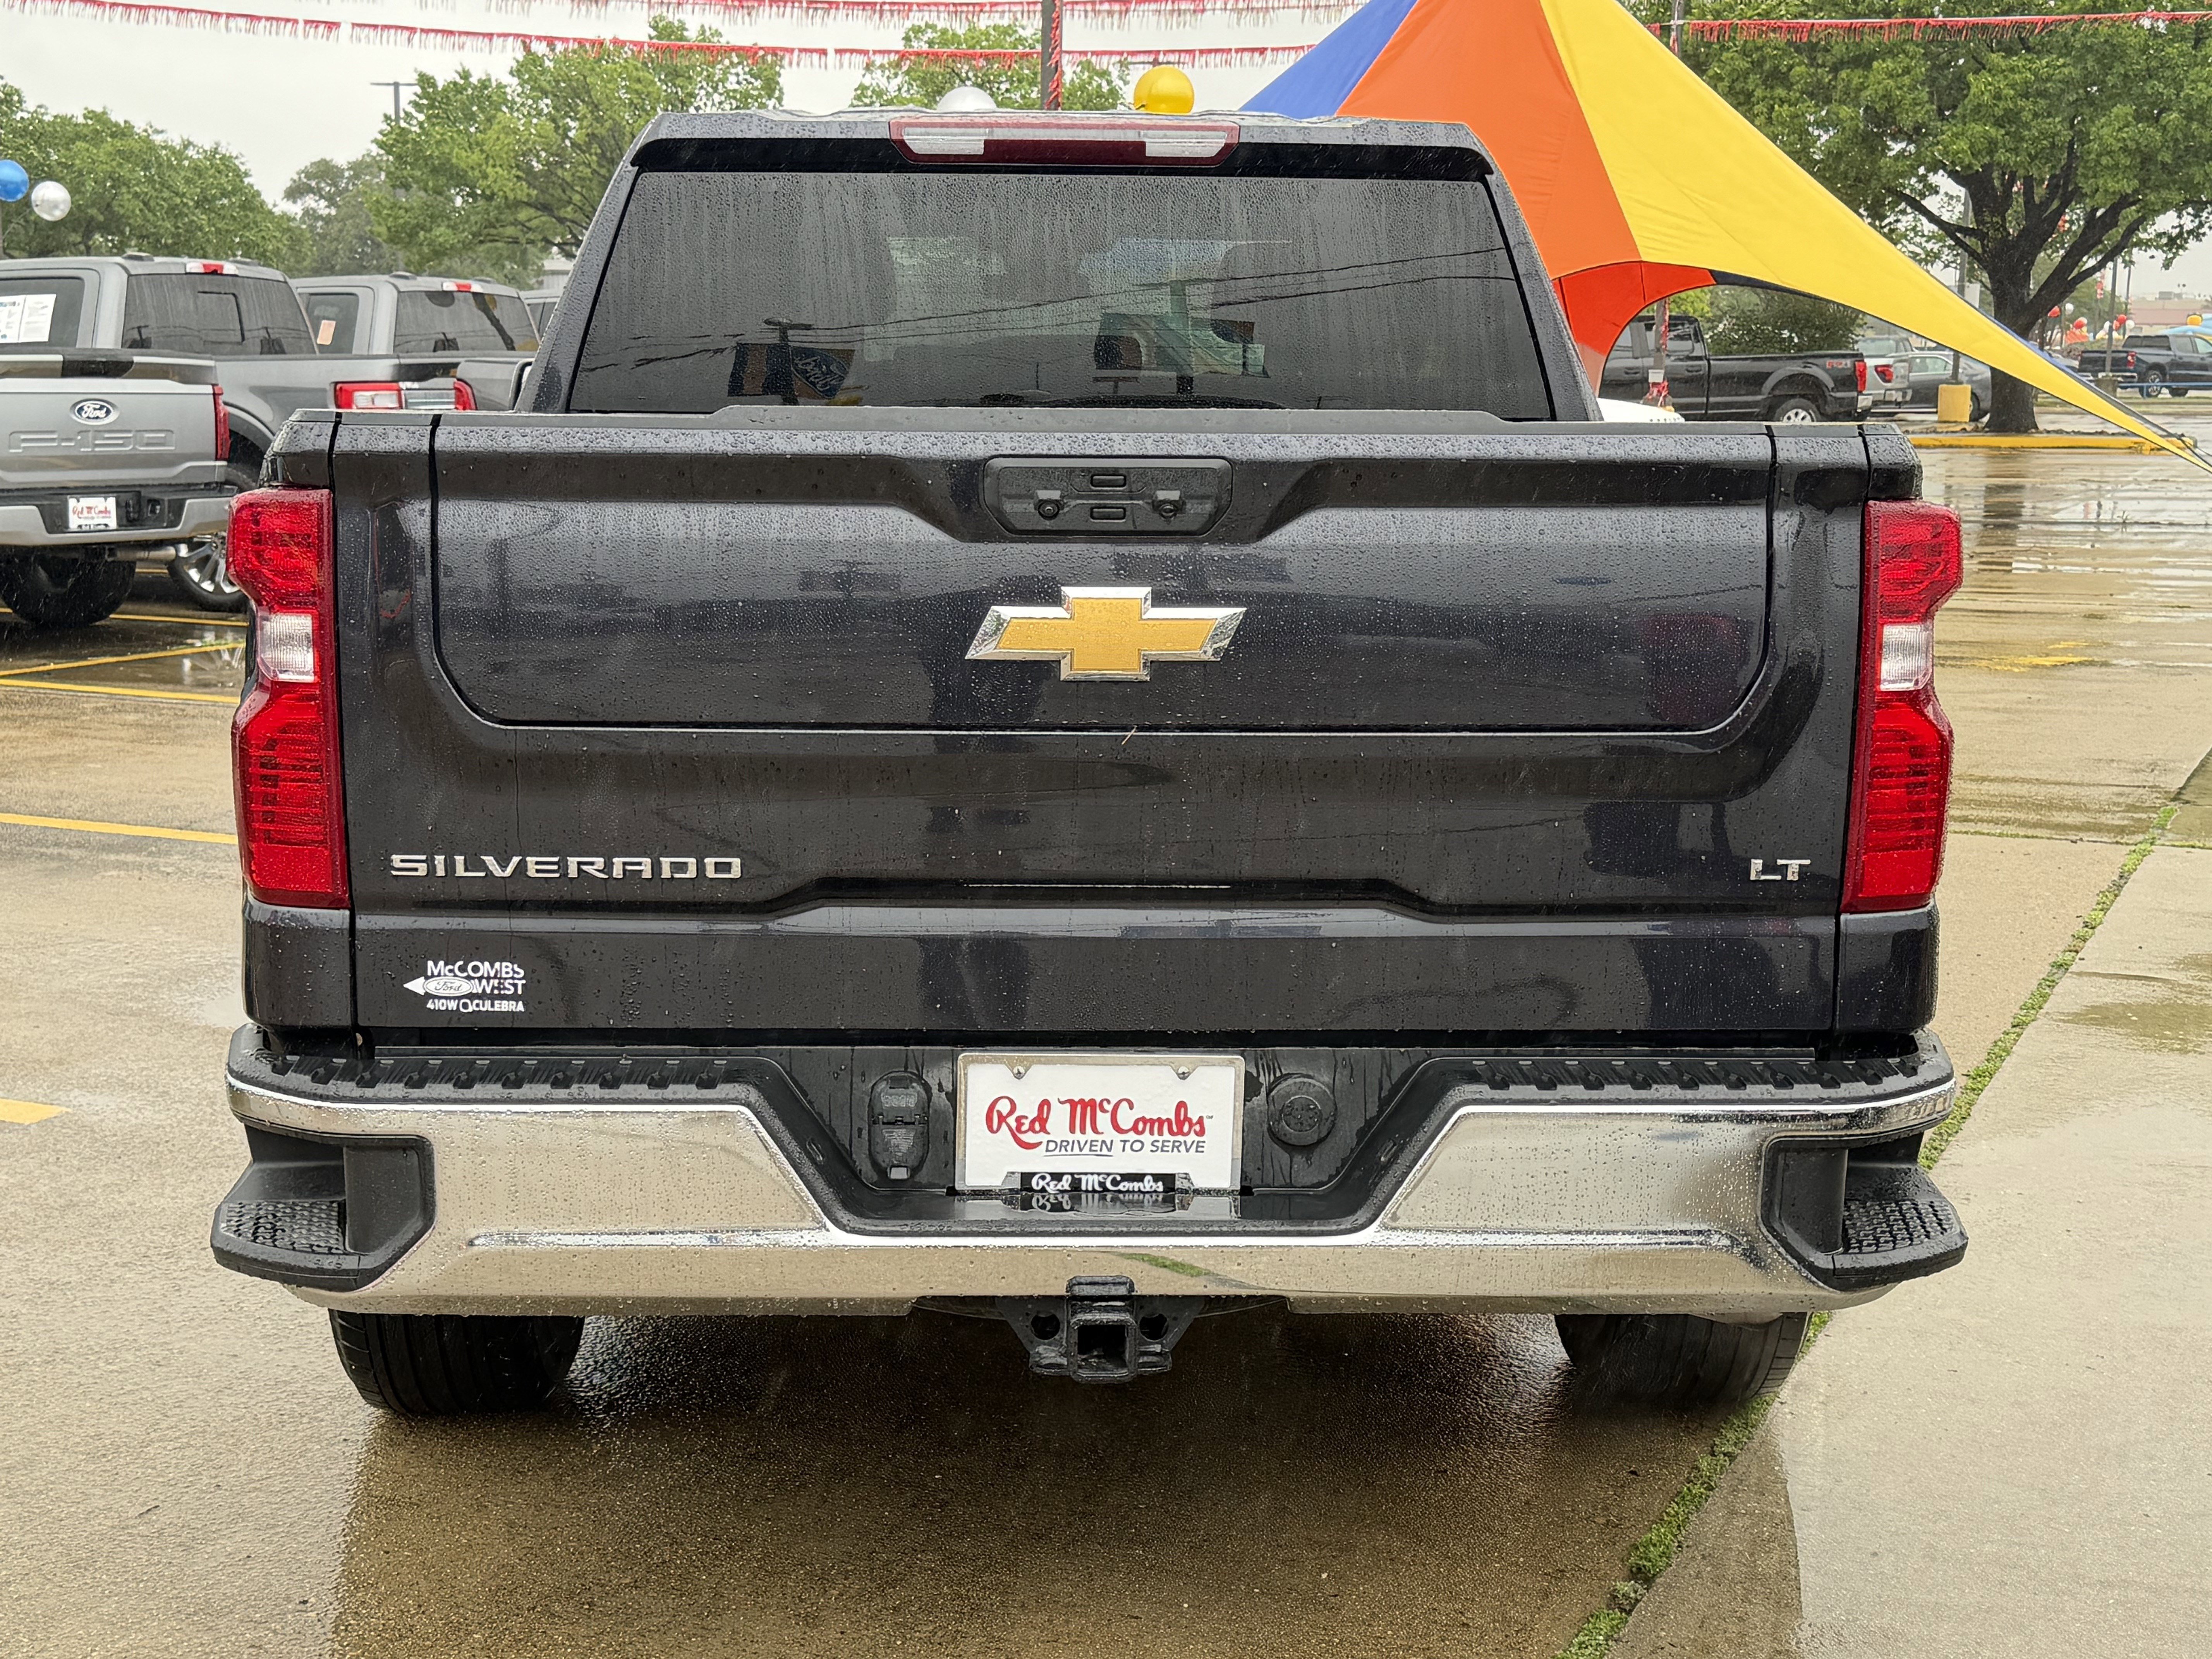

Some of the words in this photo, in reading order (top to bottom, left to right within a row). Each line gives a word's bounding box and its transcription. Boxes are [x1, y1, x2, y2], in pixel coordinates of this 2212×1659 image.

[81, 403, 107, 419] Ford
[9, 429, 175, 452] F-150
[390, 854, 741, 879] SILVERADO
[1750, 859, 1811, 881] LT
[427, 960, 525, 978] McCOMBS
[435, 981, 463, 992] Ford
[985, 1096, 1051, 1150] Red
[1057, 1097, 1206, 1137] McCombs
[1045, 1139, 1114, 1153] DRIVEN
[1121, 1139, 1145, 1153] TO
[1149, 1140, 1207, 1154] SERVE
[1031, 1173, 1072, 1194] Red
[1074, 1174, 1163, 1192] McCombs
